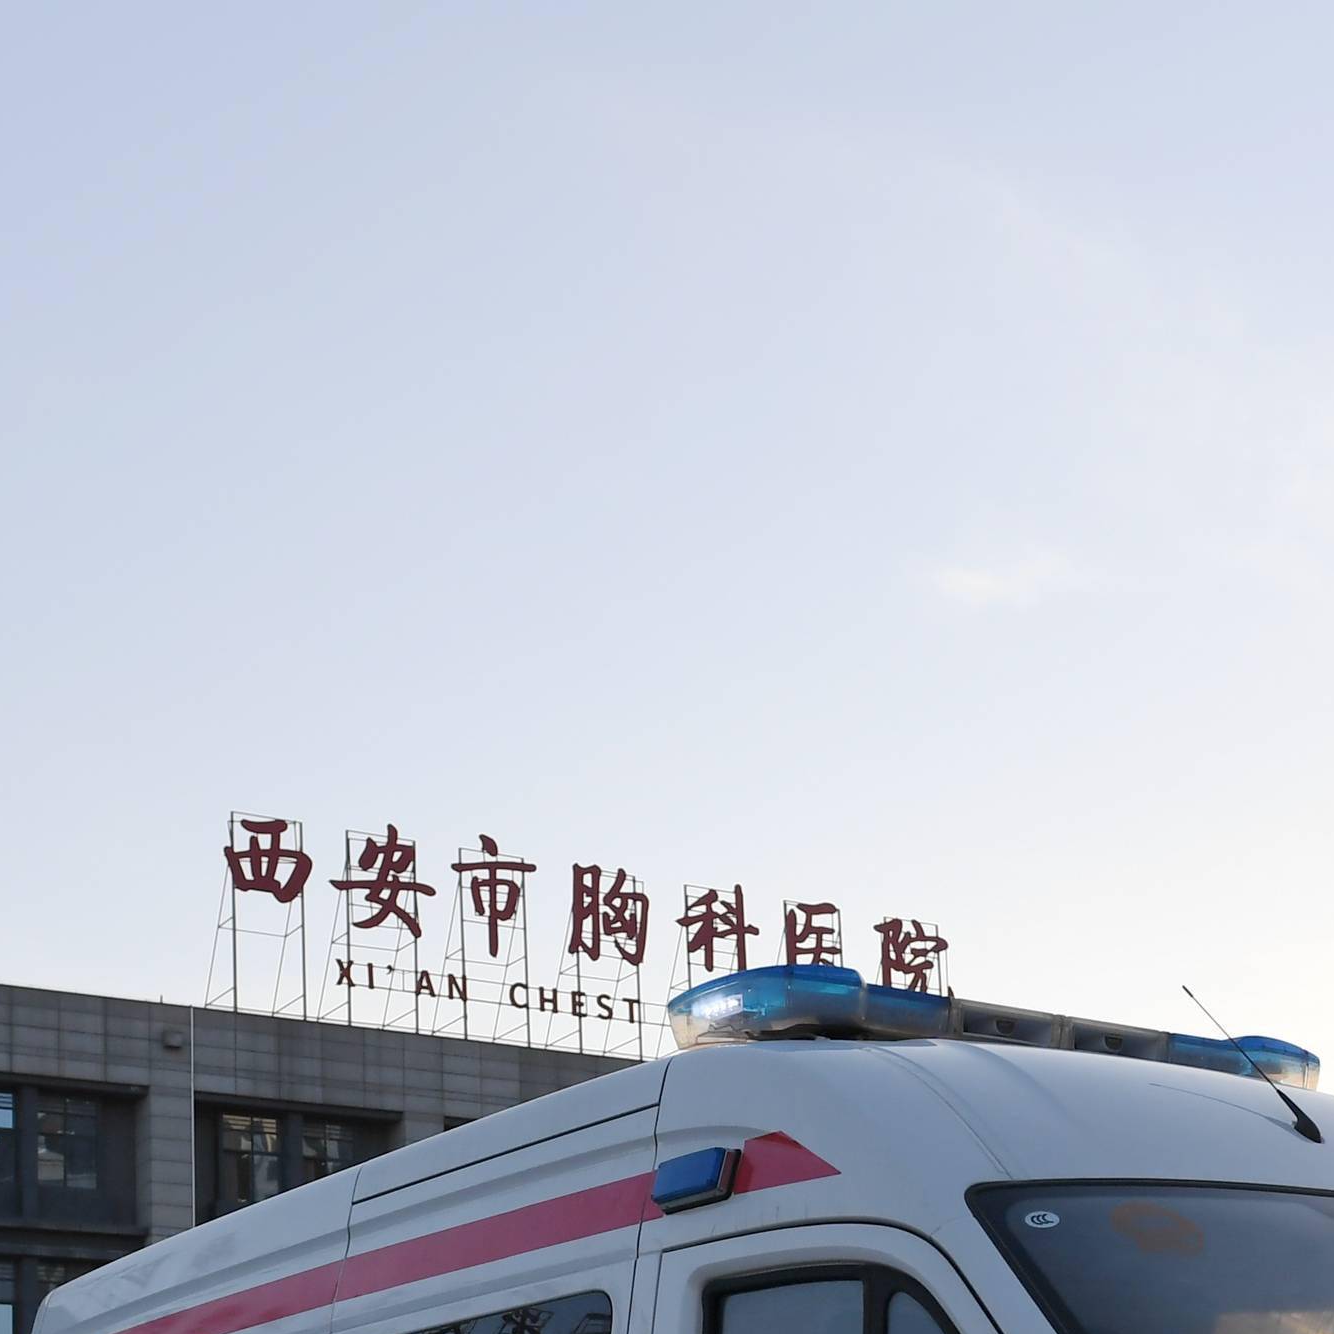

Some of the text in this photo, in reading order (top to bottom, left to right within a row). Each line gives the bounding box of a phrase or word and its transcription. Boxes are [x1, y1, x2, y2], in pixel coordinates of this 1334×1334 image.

[225, 818, 948, 996] 西安市胸科医院
[510, 982, 643, 1025] CHEST
